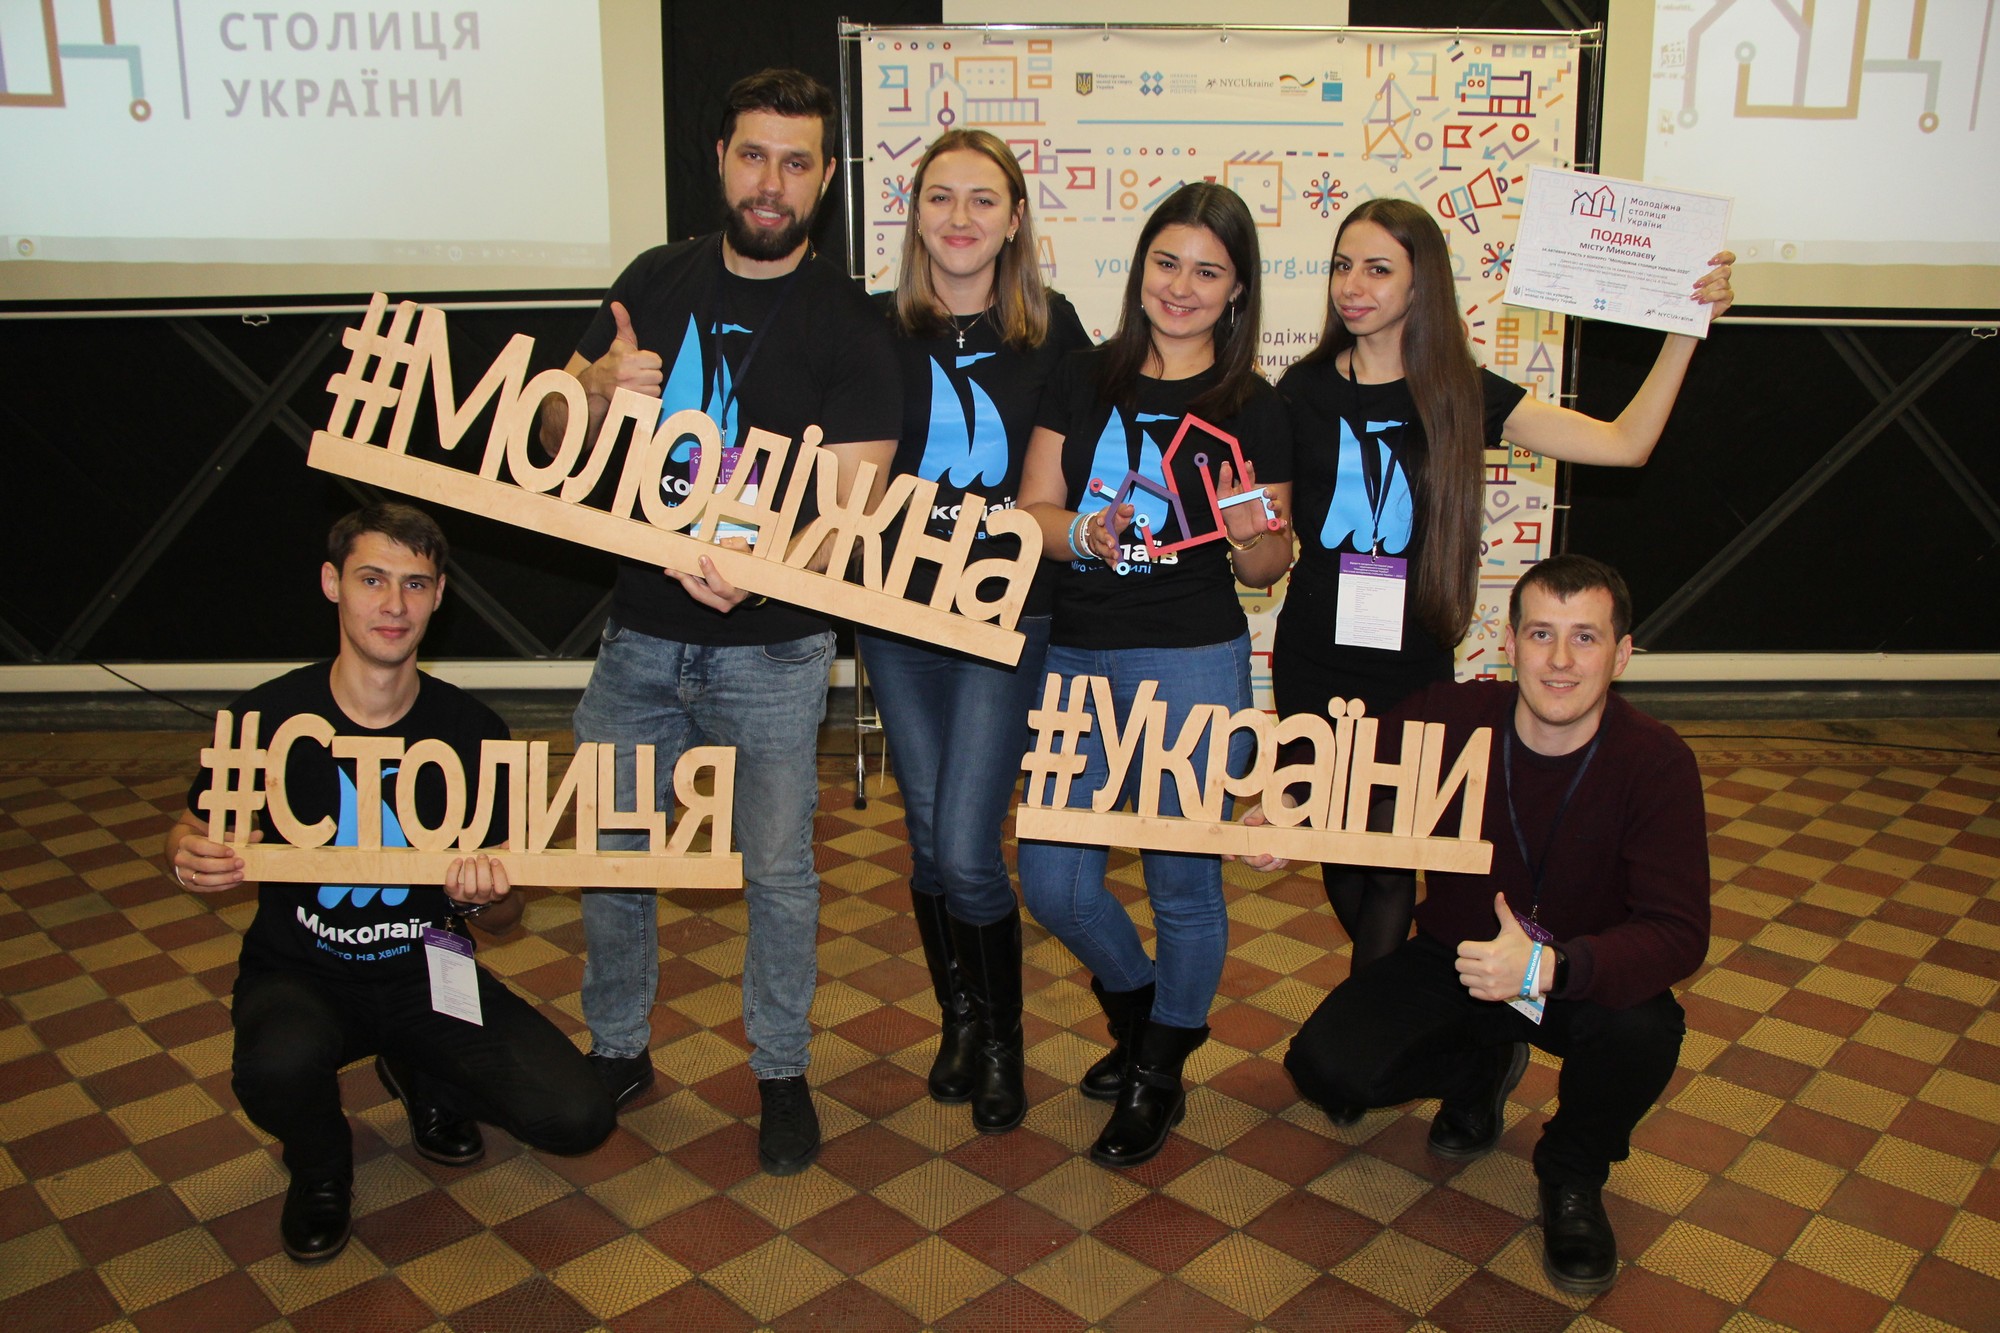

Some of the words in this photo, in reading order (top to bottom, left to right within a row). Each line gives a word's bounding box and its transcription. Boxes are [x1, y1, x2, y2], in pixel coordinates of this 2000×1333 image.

[218, 11, 482, 60] СТОЛИЦЯ
[1219, 78, 1275, 89] NYCUkraine
[221, 69, 464, 118] УКРАЇНИ
[1630, 197, 1681, 212] Молодіжна
[1627, 217, 1662, 229] України
[1628, 208, 1667, 220] столиця
[1590, 228, 1652, 248] ПОДЯКА
[1606, 245, 1656, 262] Миколаєву
[1262, 328, 1320, 346] одіжн
[326, 291, 1043, 632] #Молодіжна
[1020, 672, 1493, 842] #України
[198, 709, 737, 856] #Столиця
[356, 952, 376, 961] на
[378, 943, 411, 960] хвилі
